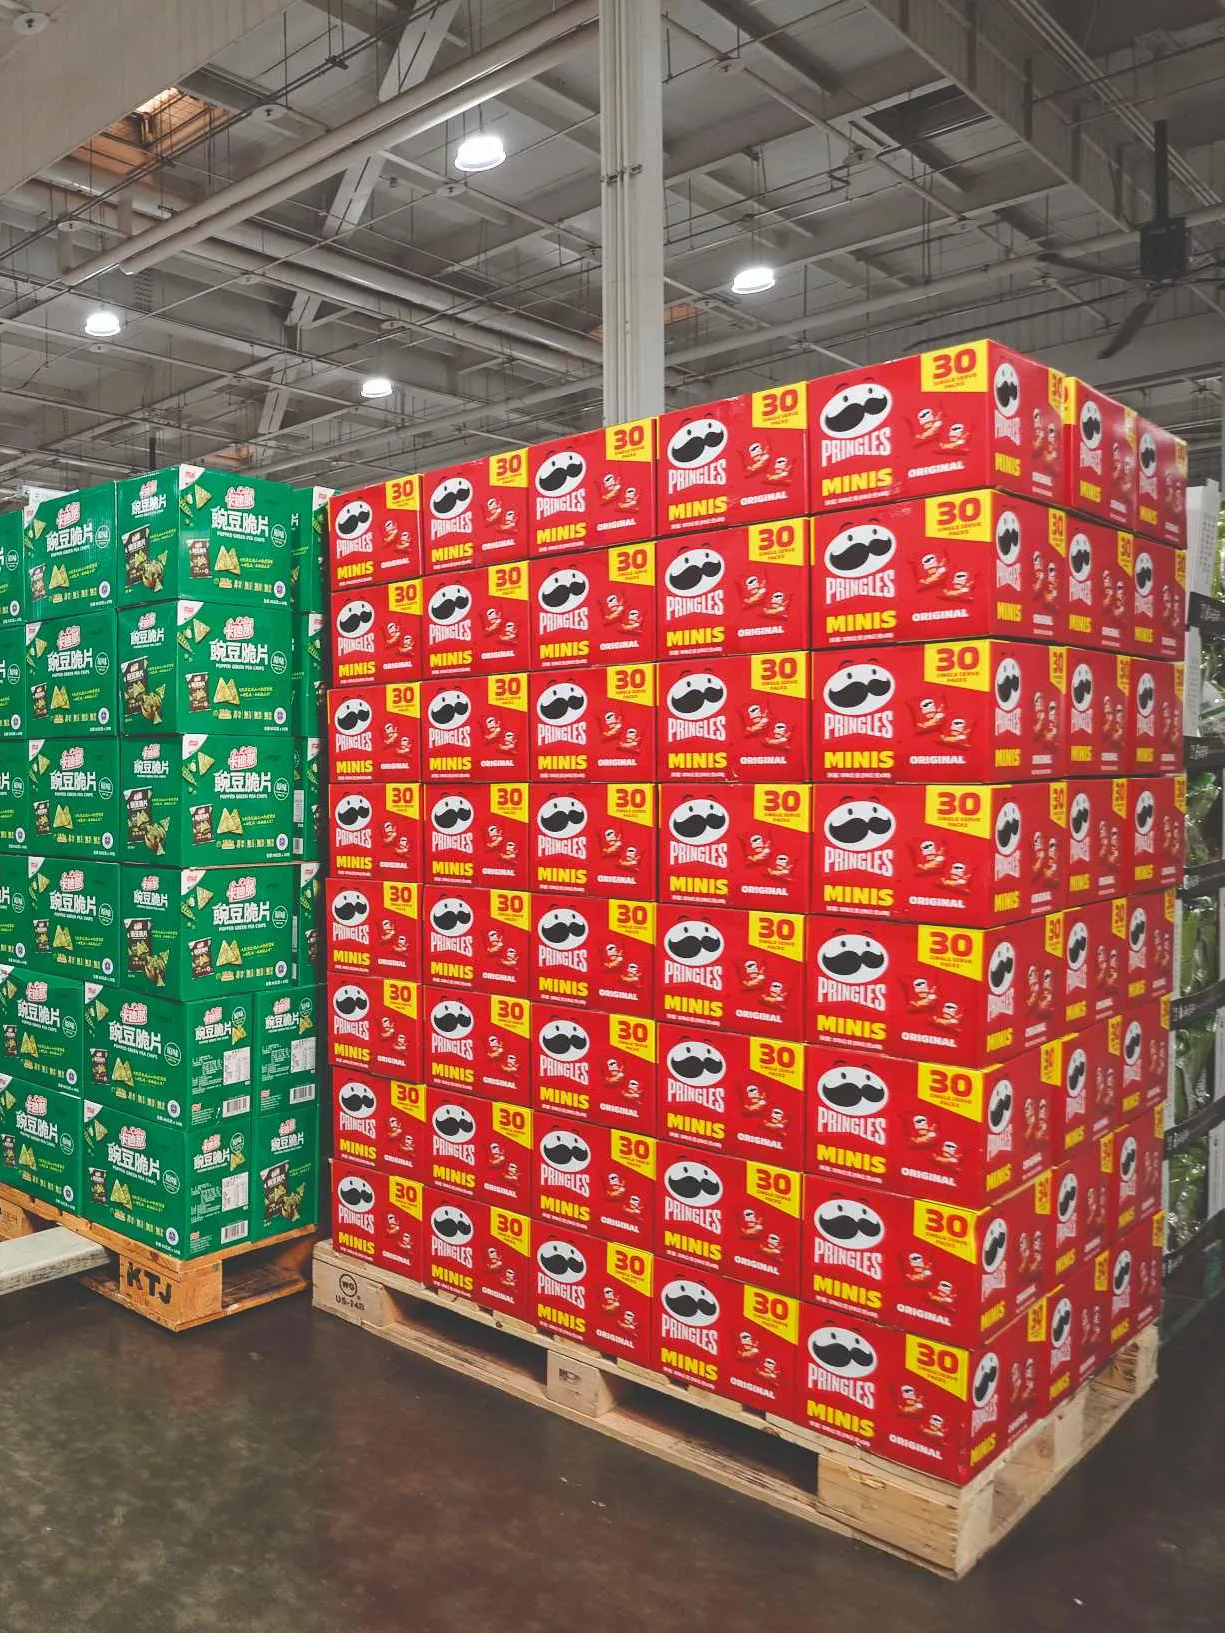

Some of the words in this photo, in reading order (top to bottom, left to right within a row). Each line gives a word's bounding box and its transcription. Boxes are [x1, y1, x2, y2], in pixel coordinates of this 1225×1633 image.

[934, 349, 976, 378] 30
[763, 390, 797, 416] 30
[615, 426, 643, 450] 30
[822, 427, 891, 467] PRINGLES
[669, 459, 726, 494] PRINGLES
[908, 460, 965, 478] ORIGINAL
[393, 480, 413, 500] 30
[822, 468, 892, 496] MINIS
[537, 488, 585, 520] PRINGLES
[669, 496, 727, 520] MINIS
[740, 491, 788, 506] ORIGINAL
[211, 507, 268, 537] 豌豆脆片
[938, 498, 981, 525] 30
[537, 523, 586, 544] MINIS
[597, 518, 636, 532] ORIGINAL
[337, 532, 372, 558] PRINGLES
[759, 526, 794, 549] 30
[337, 561, 374, 579] MINIS
[496, 567, 521, 587] 30
[826, 570, 895, 604] PRINGLES
[666, 590, 723, 620] PRINGLES
[912, 609, 969, 622] ORIGINAL
[429, 620, 471, 644] PRINGLES
[737, 626, 784, 637] ORIGINAL
[826, 610, 896, 633] MINIS
[667, 626, 725, 647] MINIS
[209, 639, 268, 664] 豌豆脆片
[430, 650, 472, 667] MINIS
[937, 647, 979, 671] 30
[615, 669, 645, 689] 30
[761, 658, 797, 680] 30
[538, 722, 586, 745] PRINGLES
[668, 716, 726, 742] PRINGLES
[825, 711, 893, 739] PRINGLES
[538, 755, 587, 770] MINIS
[668, 752, 727, 768] MINIS
[740, 757, 787, 765] ORIGINAL
[825, 751, 894, 768] MINIS
[909, 756, 966, 764] ORIGINAL
[214, 770, 271, 792] 豌豆脆片
[393, 788, 413, 804] 30
[765, 791, 800, 812] 30
[938, 792, 981, 816] 30
[336, 827, 371, 848] PRINGLES
[337, 856, 372, 869] MINIS
[670, 840, 727, 868] PRINGLES
[825, 845, 893, 877] PRINGLES
[670, 876, 728, 895] MINIS
[741, 885, 788, 896] ORIGINAL
[824, 885, 893, 906] MINIS
[212, 902, 270, 925] 豌豆脆片
[498, 894, 523, 913] 30
[618, 904, 647, 925] 30
[909, 896, 965, 909] ORIGINAL
[759, 918, 795, 940] 30
[431, 931, 472, 957] PRINGLES
[930, 932, 972, 957] 30
[539, 944, 587, 972] PRINGLES
[431, 962, 473, 979] MINIS
[665, 959, 722, 991] PRINGLES
[539, 977, 588, 996] MINIS
[599, 989, 638, 1001] ORIGINAL
[818, 975, 886, 1011] PRINGLES
[665, 995, 723, 1017] MINIS
[736, 1009, 783, 1023] ORIGINAL
[109, 1021, 161, 1054] 豌豆脆片
[817, 1014, 886, 1040] MINIS
[901, 1031, 957, 1048] ORIGINAL
[760, 1044, 795, 1068] 30
[397, 1084, 418, 1105] 30
[668, 1077, 724, 1113] PRINGLES
[930, 1069, 972, 1098] 30
[339, 1110, 375, 1139] PRINGLES
[667, 1113, 725, 1139] MINIS
[818, 1105, 886, 1146] PRINGLES
[340, 1139, 376, 1159] MINIS
[620, 1136, 649, 1159] 30
[737, 1132, 784, 1150] ORIGINAL
[107, 1142, 160, 1181] 豌豆脆片
[817, 1144, 885, 1174] MINIS
[541, 1162, 589, 1198] PRINGLES
[757, 1169, 791, 1195] 30
[901, 1167, 957, 1187] ORIGINAL
[541, 1195, 590, 1221] MINIS
[665, 1195, 721, 1235] PRINGLES
[498, 1214, 522, 1236] 30
[601, 1216, 640, 1234] ORIGINAL
[926, 1208, 967, 1240] 30
[432, 1234, 472, 1269] PRINGLES
[665, 1231, 721, 1260] MINIS
[734, 1255, 780, 1276] ORIGINAL
[815, 1236, 882, 1281] PRINGLES
[127, 1261, 172, 1305] KTJ
[432, 1264, 473, 1290] MINIS
[814, 1275, 881, 1308] MINIS
[754, 1292, 788, 1320] 30
[897, 1303, 952, 1327] ORIGINAL
[662, 1312, 717, 1356] PRINGLES
[661, 1348, 717, 1380] MINIS
[917, 1343, 958, 1374] 30
[730, 1376, 775, 1400] ORIGINAL
[808, 1361, 874, 1410] PRINGLES
[807, 1400, 874, 1437] MINIS
[889, 1433, 943, 1461] ORIGINAL
